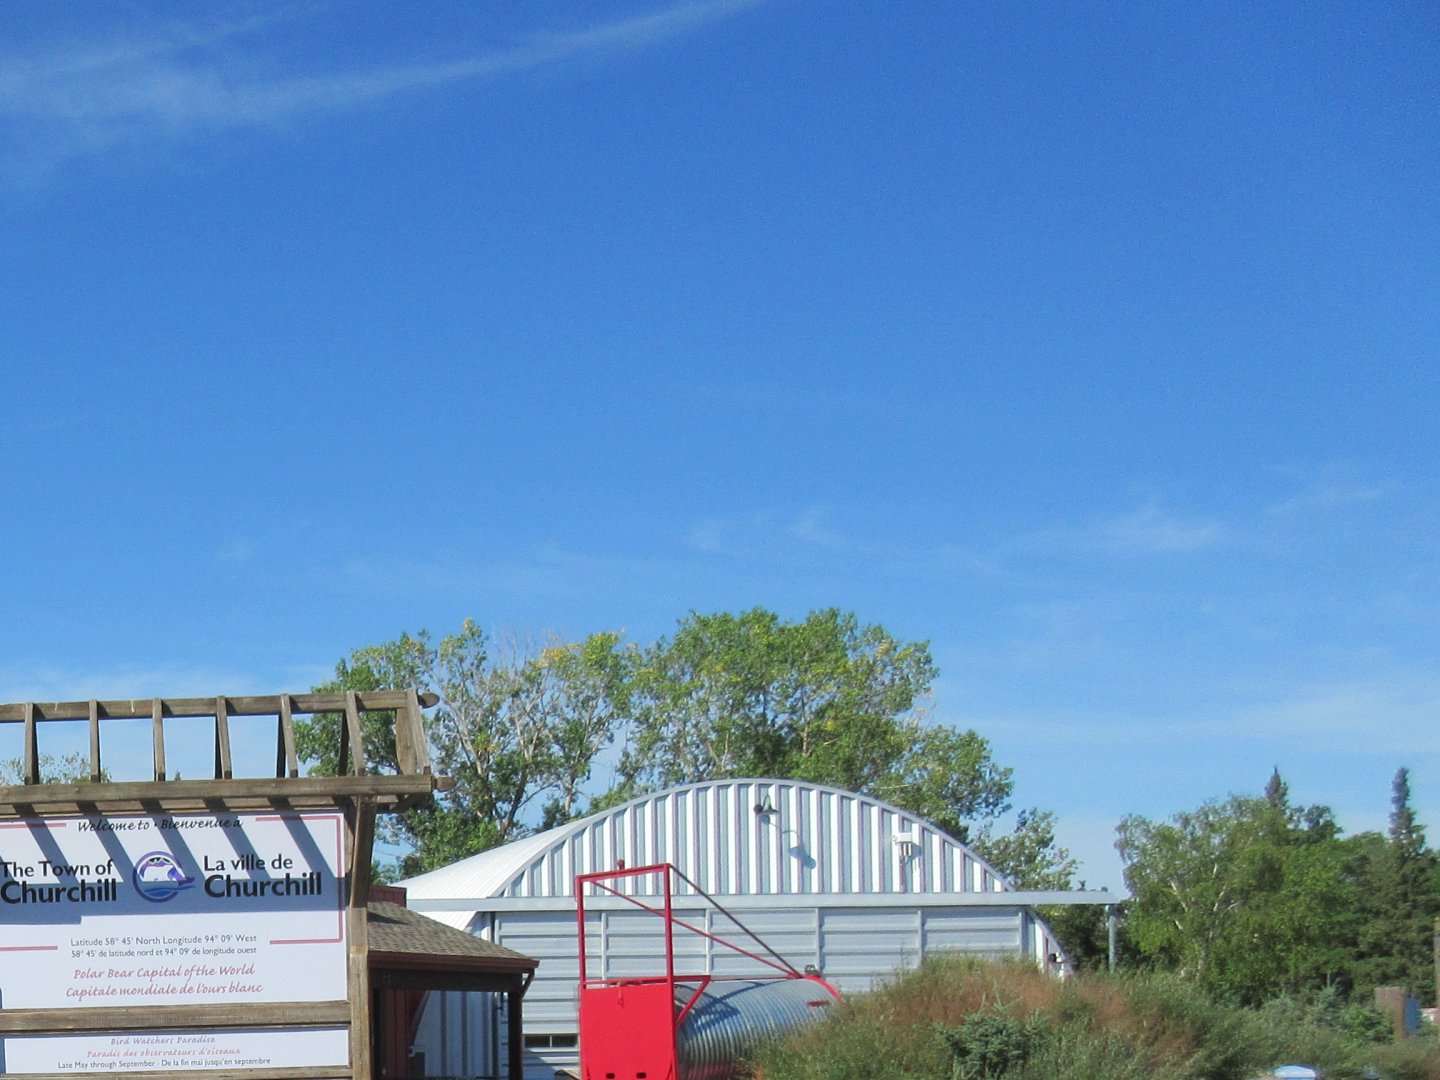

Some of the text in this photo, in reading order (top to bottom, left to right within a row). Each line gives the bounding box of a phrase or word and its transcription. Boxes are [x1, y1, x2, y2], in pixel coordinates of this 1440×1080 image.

[78, 819, 137, 832] Welcome
[138, 820, 149, 830] to
[161, 818, 231, 829] Bienvenue
[0, 859, 113, 877] The Town of
[204, 853, 293, 871] La ville de
[0, 878, 117, 904] Churchill
[204, 872, 322, 898] Churchill
[70, 938, 103, 947] Latitude
[135, 936, 160, 945] North
[163, 936, 202, 946] Longitude
[236, 934, 257, 943] West
[98, 949, 108, 958] de
[109, 949, 135, 957] latitude
[137, 948, 154, 957] nord
[192, 947, 201, 955] de
[202, 947, 236, 956] longitude
[237, 947, 257, 955] ouest
[73, 969, 105, 979] Polar
[107, 968, 133, 978] Bear
[136, 965, 182, 982] Capital
[219, 963, 256, 975] World
[66, 981, 264, 1001] Capitale mondiale de l'ours blanc
[111, 1037, 129, 1045] Bird
[177, 1035, 215, 1044] Paradise
[75, 1061, 88, 1069] May
[90, 1061, 117, 1069] through
[119, 1060, 155, 1068] September
[234, 1057, 271, 1066] septembre
